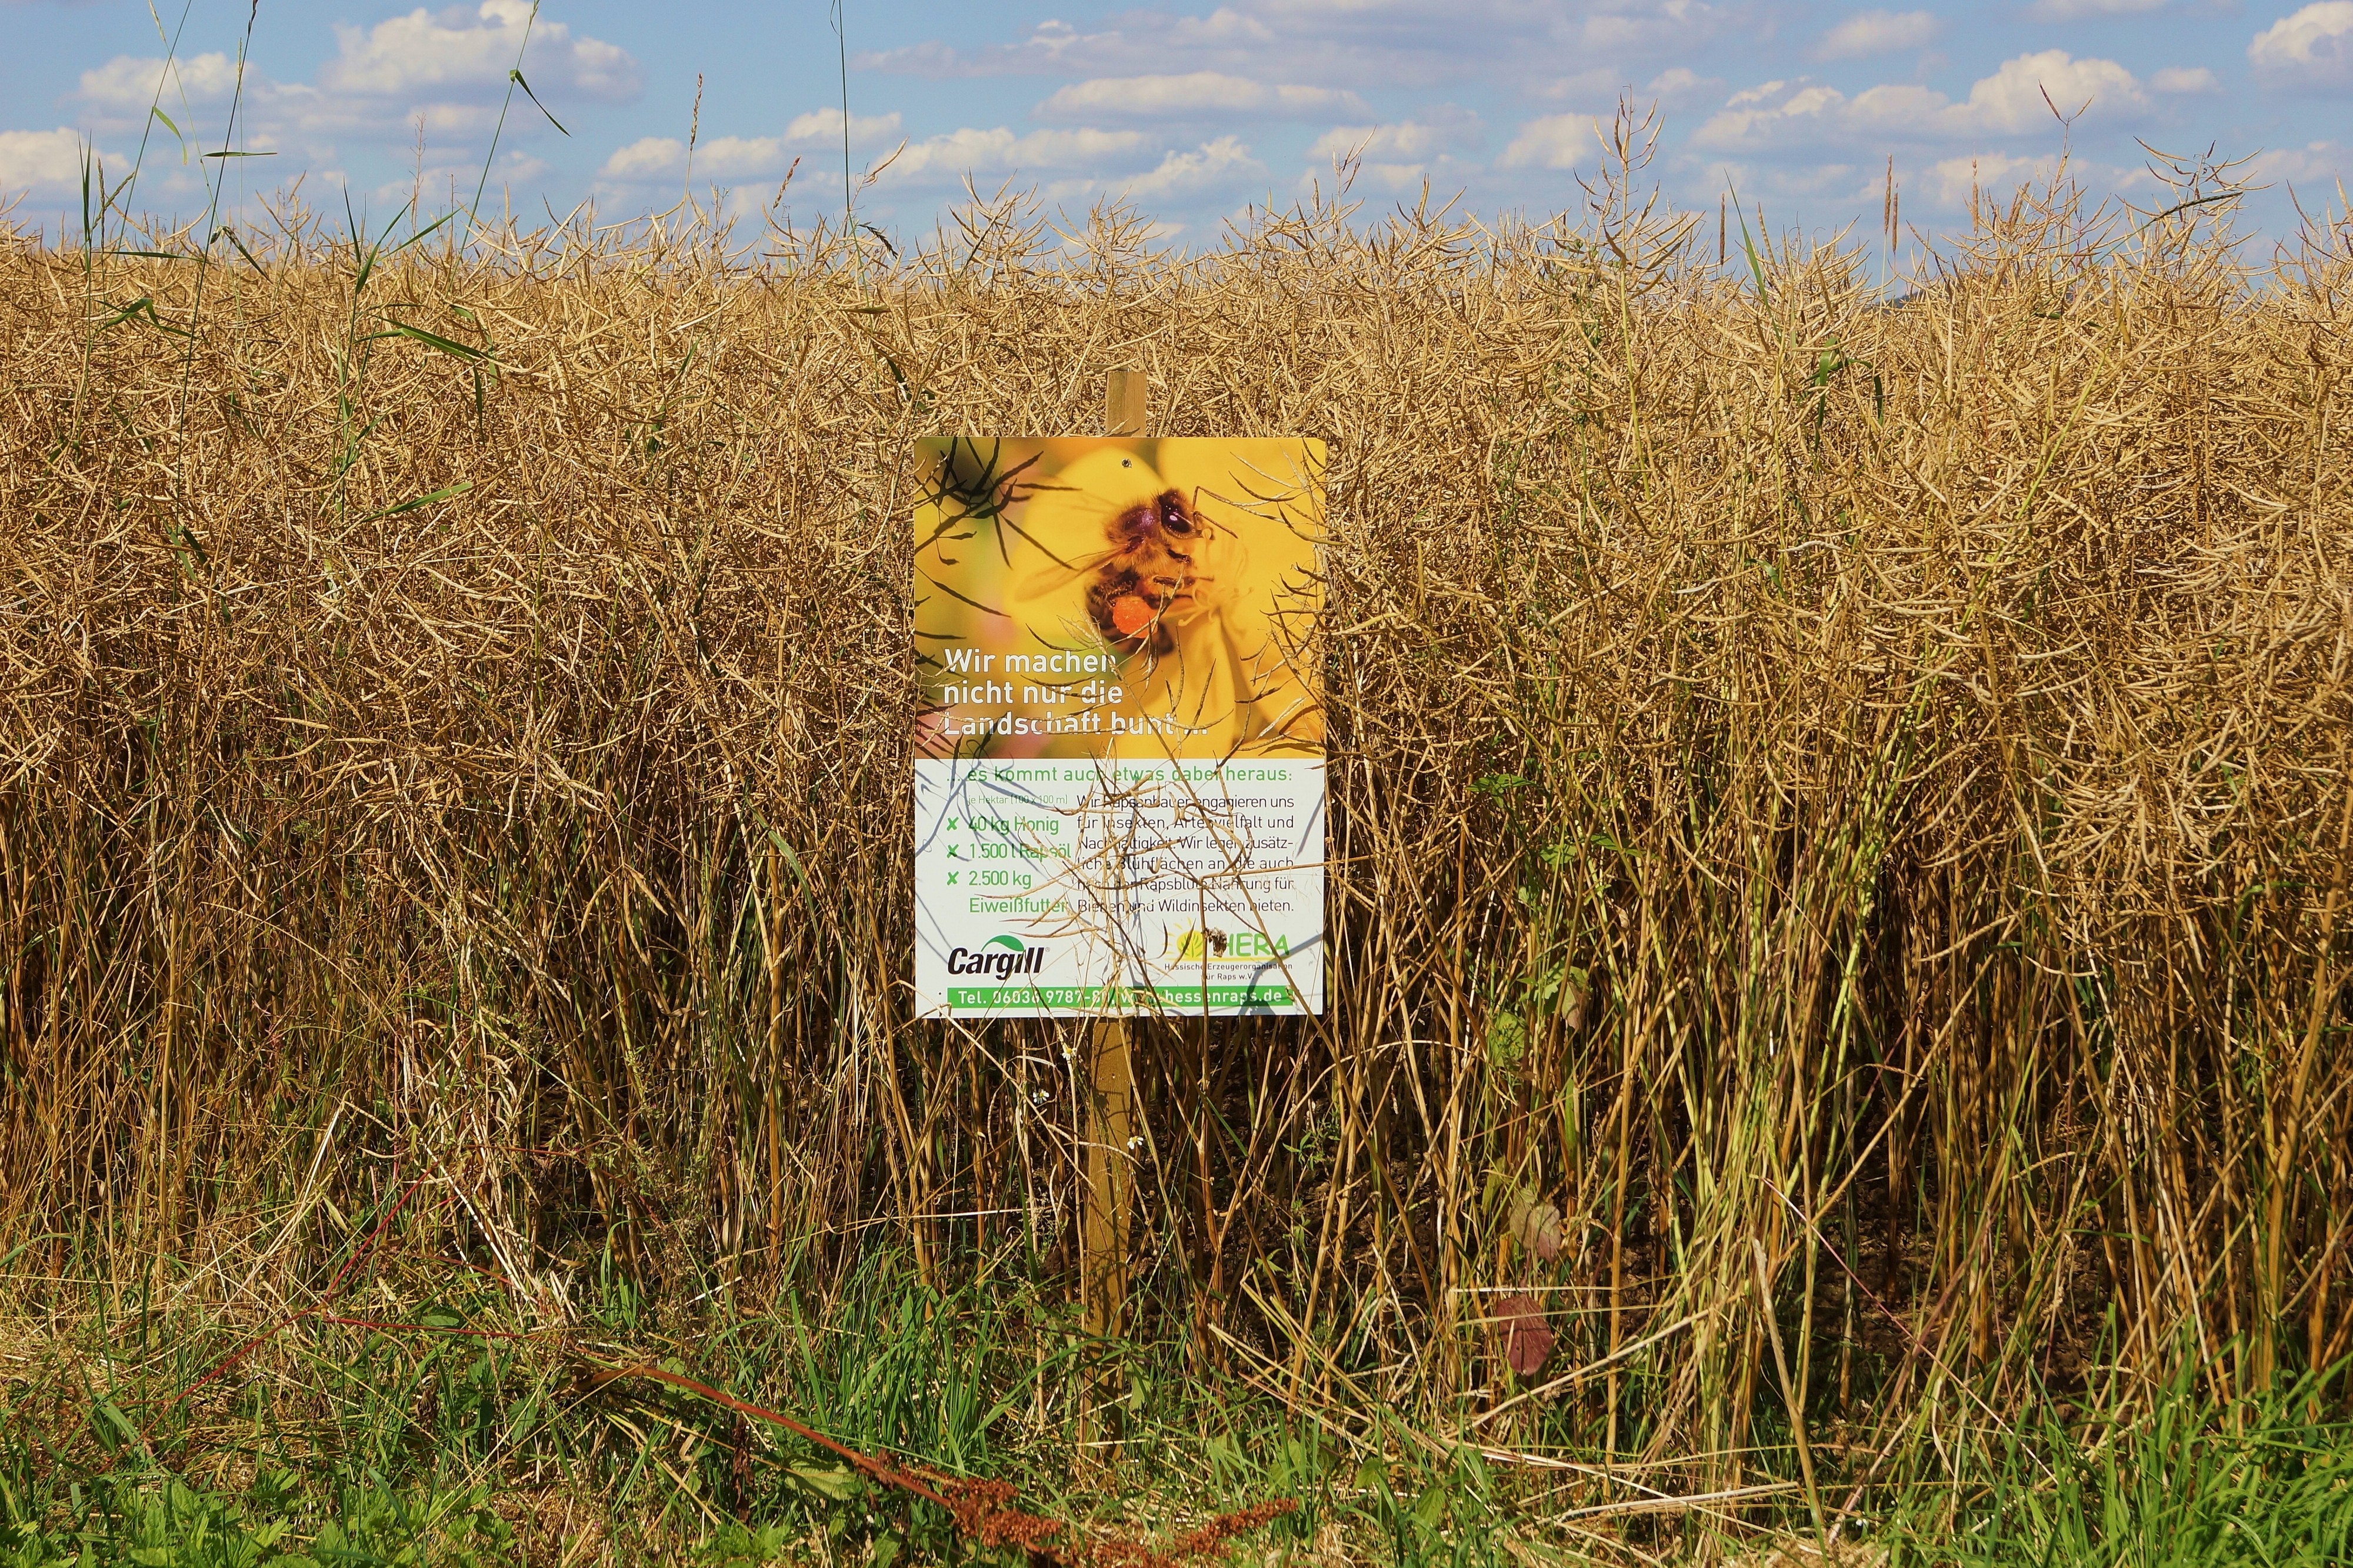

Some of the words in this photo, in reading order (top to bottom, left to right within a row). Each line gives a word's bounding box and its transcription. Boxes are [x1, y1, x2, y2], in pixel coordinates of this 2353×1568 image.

[944, 648, 996, 672] Wir
[1005, 649, 1116, 672] machen
[944, 680, 1014, 704] nicht
[1023, 685, 1072, 704] nur
[1081, 680, 1123, 704] die
[944, 710, 1101, 735] Landschaft
[1111, 710, 1176, 735] bunt
[967, 770, 988, 782] es
[994, 766, 1058, 782] kommt
[1112, 767, 1165, 781] etwas
[1225, 766, 1292, 781] heraus:
[968, 795, 976, 806] je
[978, 795, 1009, 804] Hektar
[1011, 795, 1029, 805] (100
[1039, 795, 1054, 804] 100
[1056, 795, 1068, 804] m)
[1076, 795, 1101, 808] Wir
[1198, 795, 1267, 812] engagieren
[1271, 798, 1294, 808] uns
[968, 816, 987, 832] 40
[991, 816, 1009, 835] kg
[1014, 816, 1059, 835] Honig
[1077, 815, 1098, 829] für
[1103, 815, 1169, 830] Insekten,
[1268, 815, 1294, 828] und
[1179, 836, 1203, 849] Wir
[1245, 836, 1293, 849] zusätz-
[969, 843, 1008, 859] 1.500
[1019, 843, 1071, 862] Rapsöl
[1259, 856, 1294, 869] auch
[968, 870, 1009, 886] 2.500
[1012, 870, 1032, 889] kg
[1212, 877, 1271, 893] Nahrung
[1274, 877, 1294, 890] für
[969, 897, 1068, 913] Eiweißfutter
[1129, 899, 1154, 912] und
[1158, 899, 1245, 912] Wildinsekten
[948, 947, 1045, 980] Cargill
[1207, 963, 1292, 971] Erzeugerorganisaton
[958, 990, 987, 1005] Tel.
[994, 990, 1039, 1004] 06036
